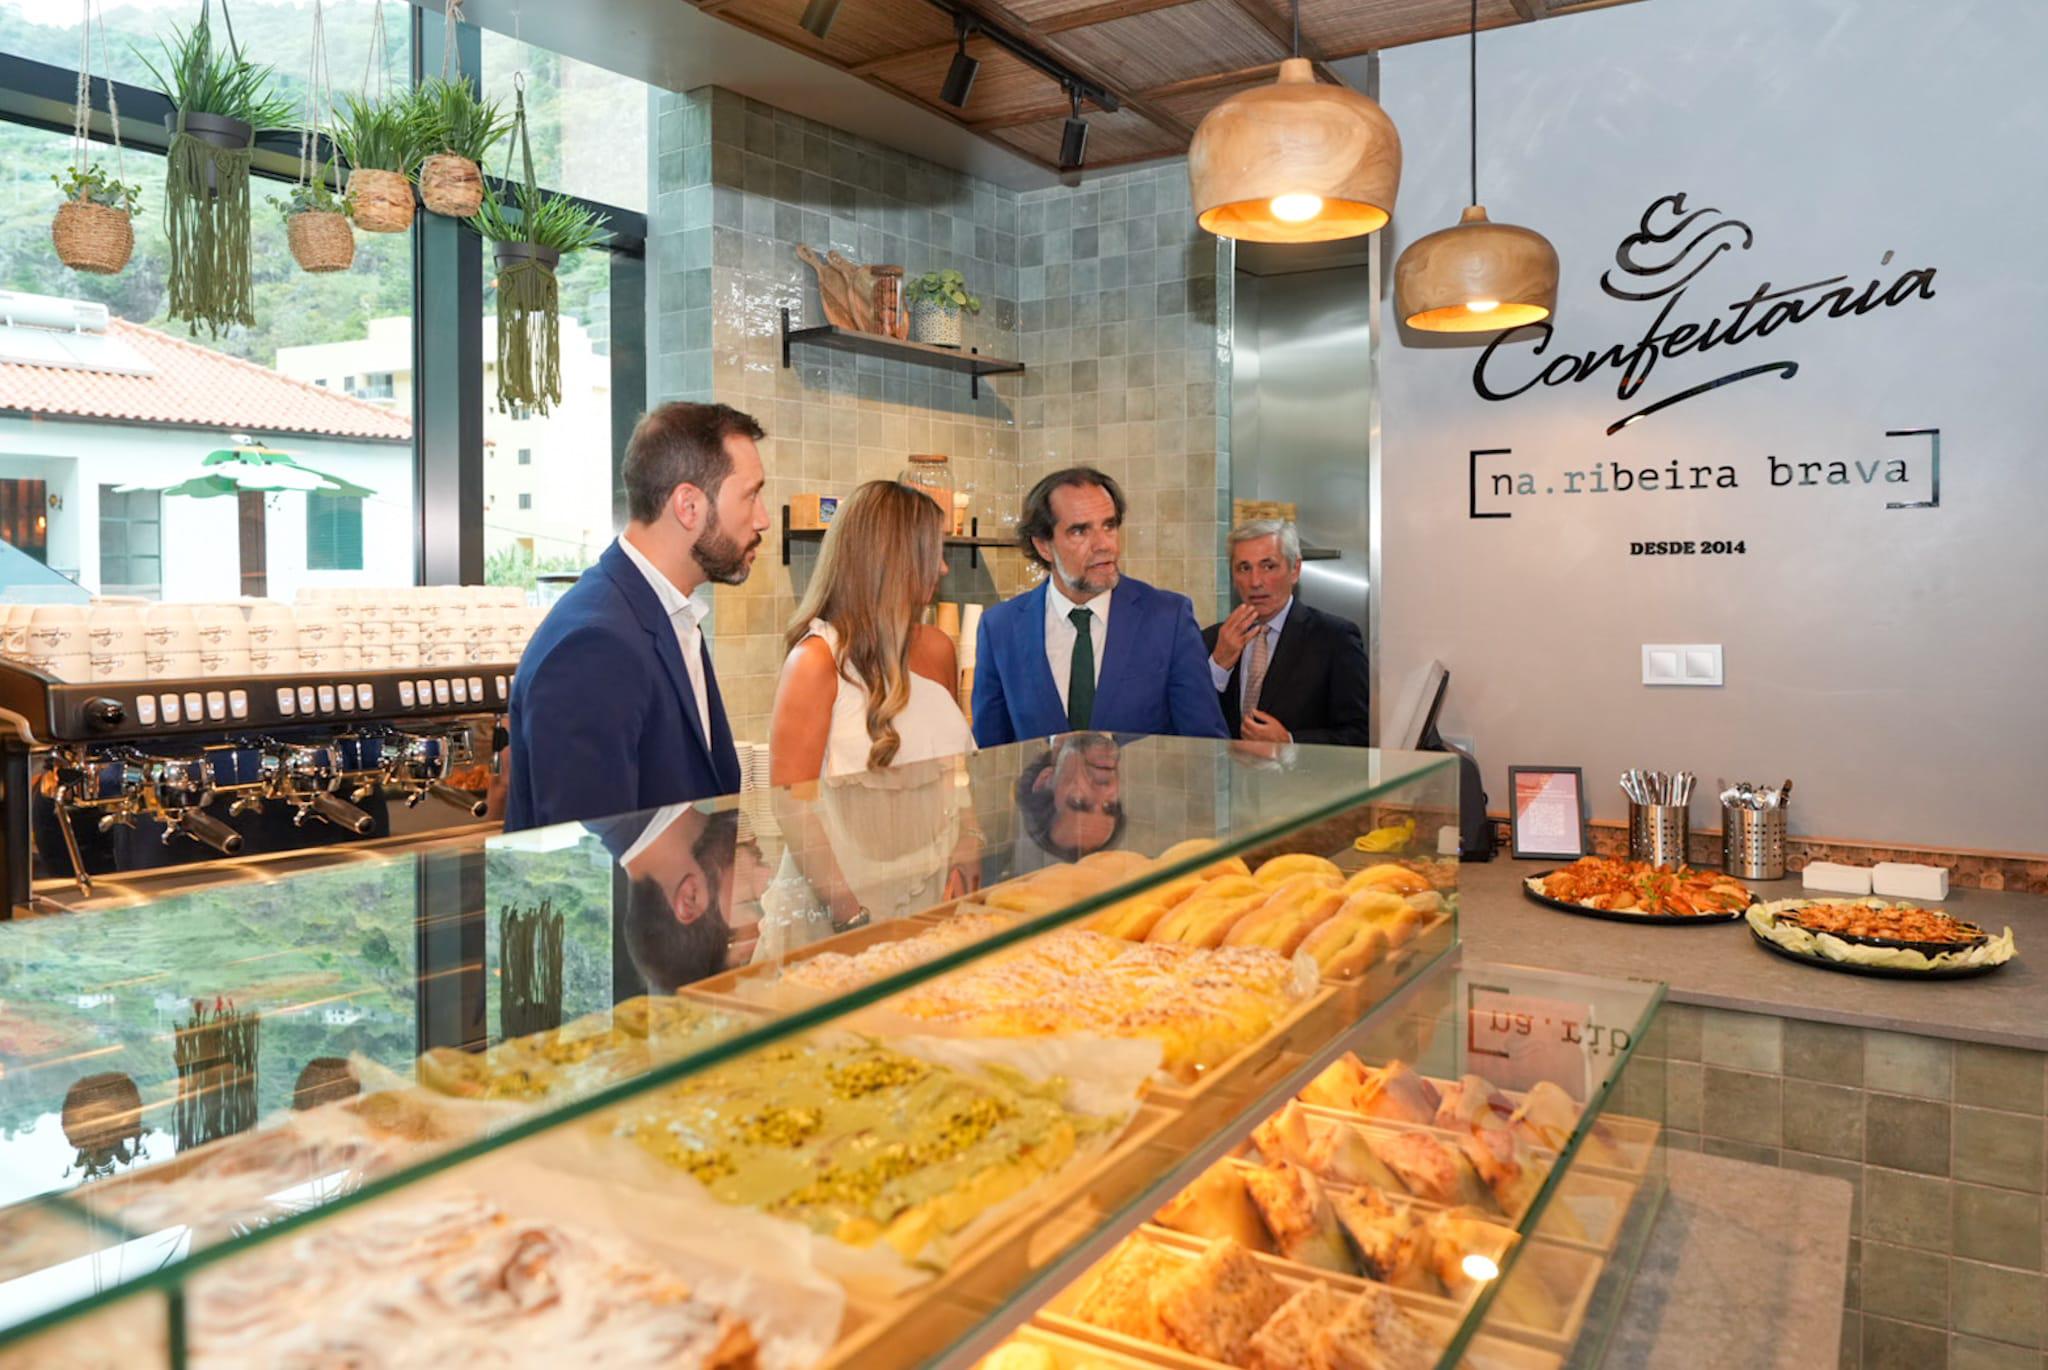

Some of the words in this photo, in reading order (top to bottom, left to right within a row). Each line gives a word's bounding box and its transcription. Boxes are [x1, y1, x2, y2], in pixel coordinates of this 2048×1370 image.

[1472, 250, 1937, 401] Confeitaria
[1491, 460, 1738, 496] na.ribeira
[1767, 456, 1909, 487] brava
[1630, 541, 1696, 555] DESDE
[1700, 540, 1746, 554] 2014
